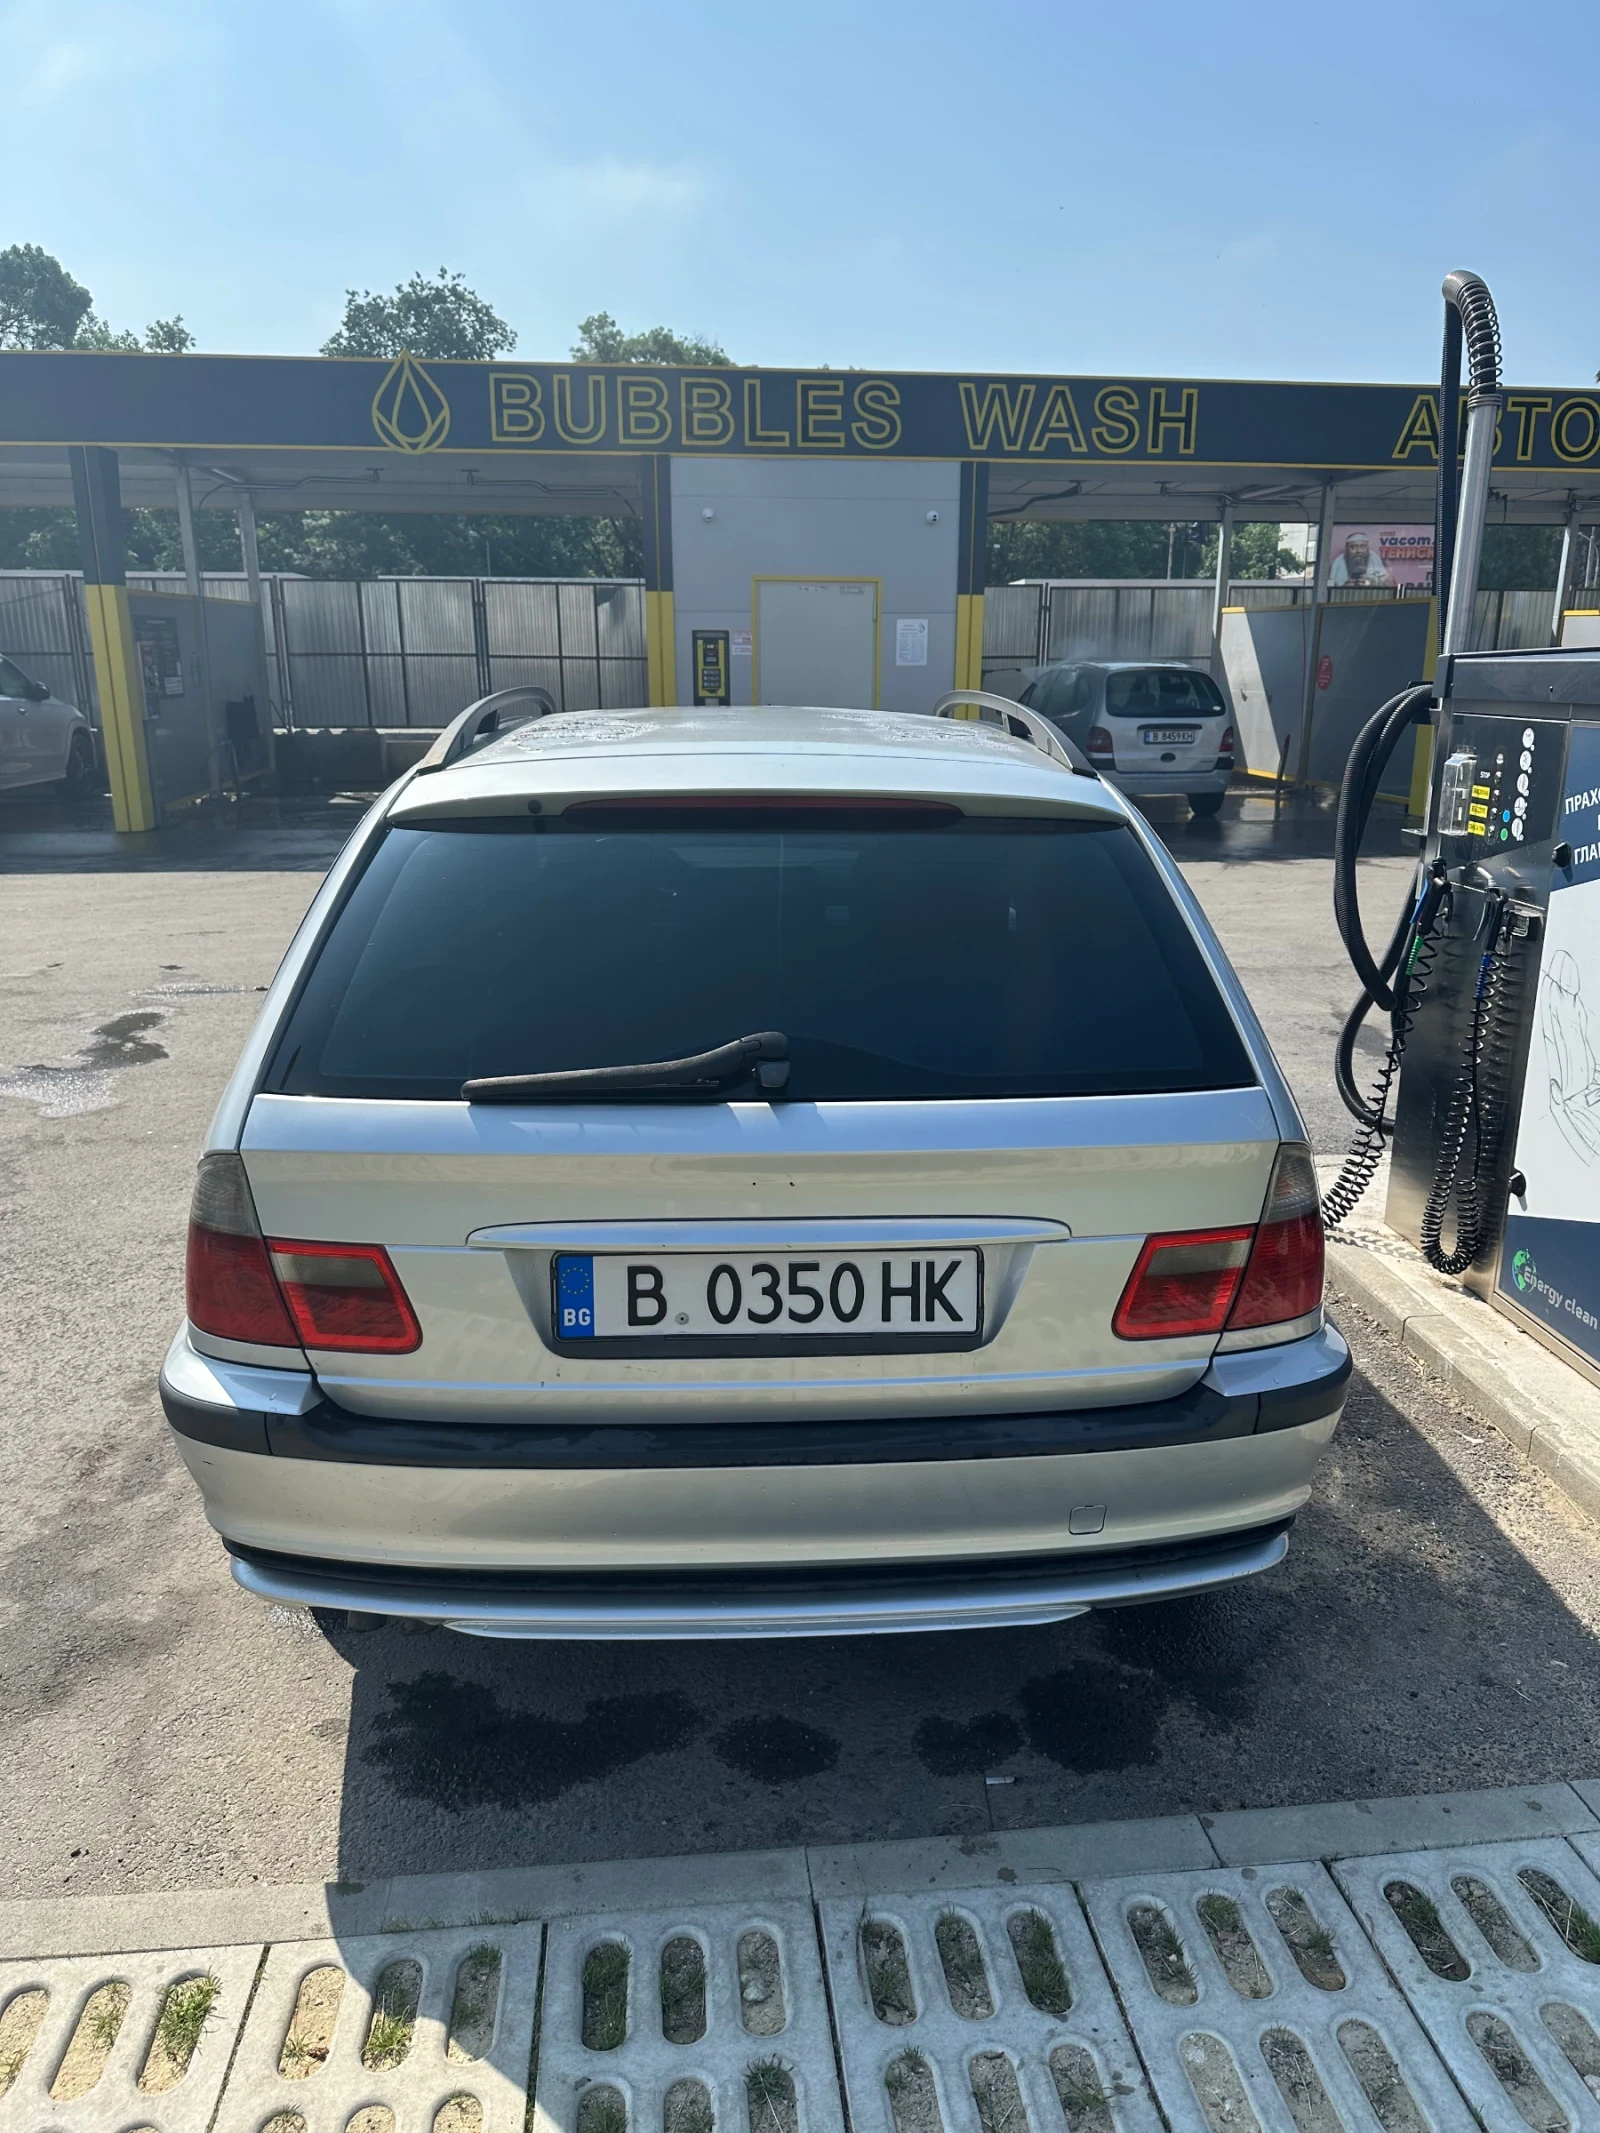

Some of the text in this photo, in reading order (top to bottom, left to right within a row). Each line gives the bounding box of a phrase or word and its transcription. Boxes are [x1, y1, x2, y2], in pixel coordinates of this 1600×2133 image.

[488, 372, 1199, 454] BUBBLES WASH
[1480, 771, 1491, 779] STOP
[1565, 787, 1600, 815] ПРАХ
[627, 1260, 964, 1327] B 0350 HK
[563, 1308, 591, 1327] BG
[1565, 1298, 1598, 1330] clean
